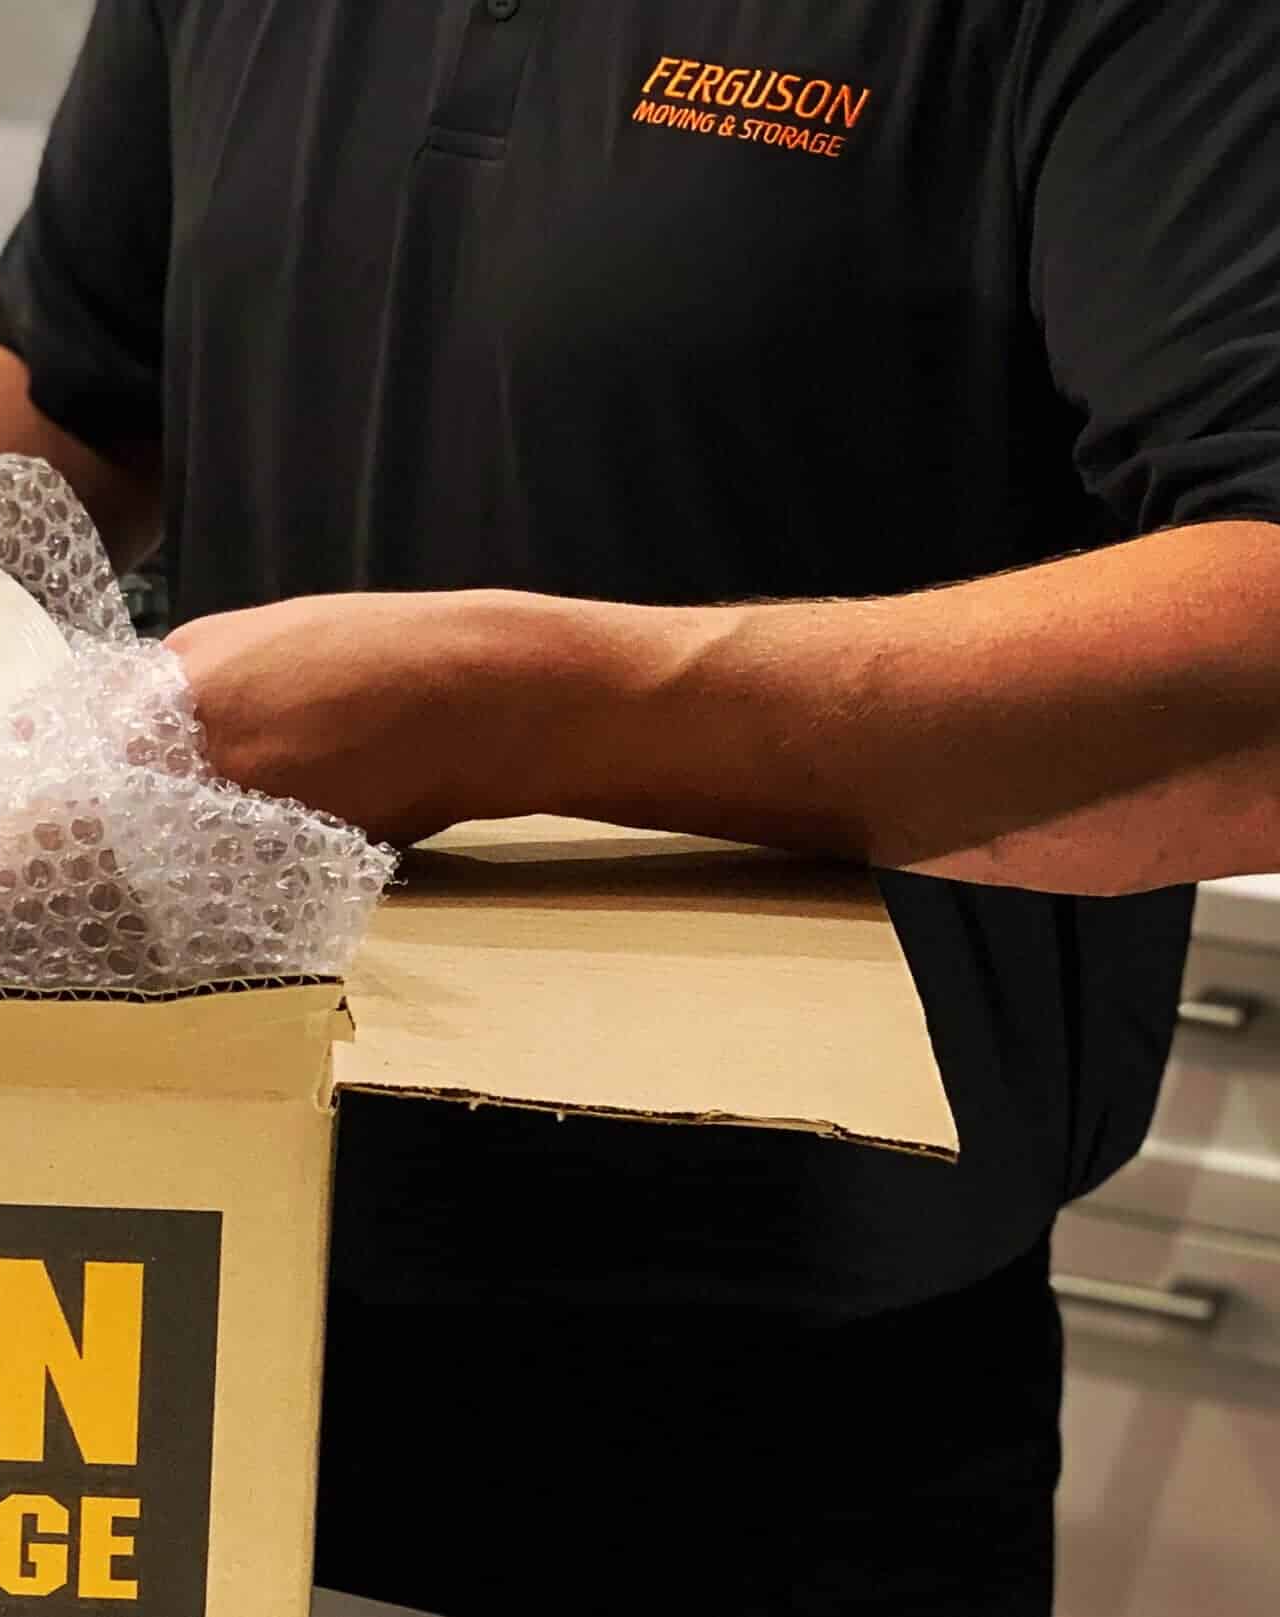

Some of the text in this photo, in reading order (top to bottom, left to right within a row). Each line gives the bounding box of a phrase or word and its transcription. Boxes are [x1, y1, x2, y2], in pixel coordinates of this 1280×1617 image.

[642, 57, 869, 128] FERGUSON
[632, 100, 844, 156] MOVING & STORAGE
